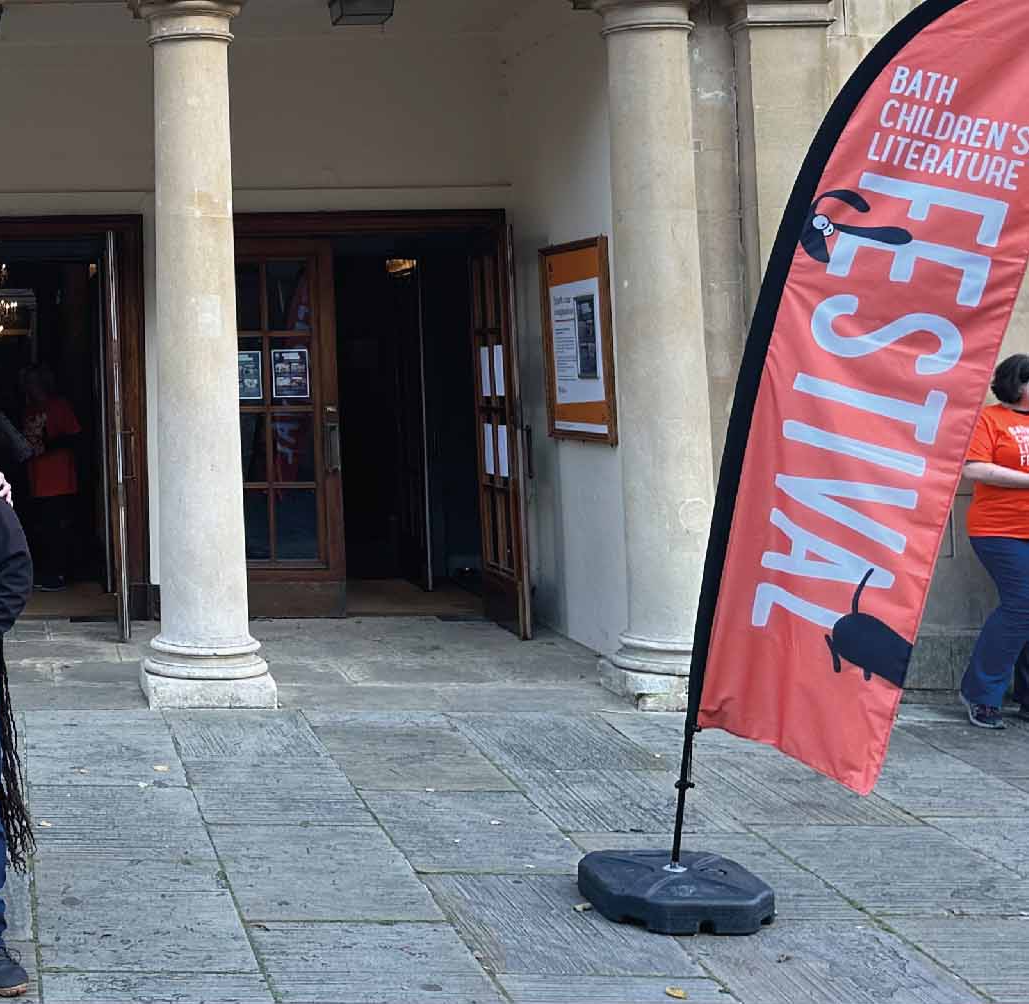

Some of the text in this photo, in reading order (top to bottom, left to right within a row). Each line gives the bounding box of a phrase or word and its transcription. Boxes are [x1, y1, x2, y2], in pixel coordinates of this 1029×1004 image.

[890, 65, 958, 106] BATH
[880, 99, 1029, 155] CHILDREN'S
[867, 131, 1025, 191] LITERATURE
[752, 172, 1009, 627] FESTIVAL
